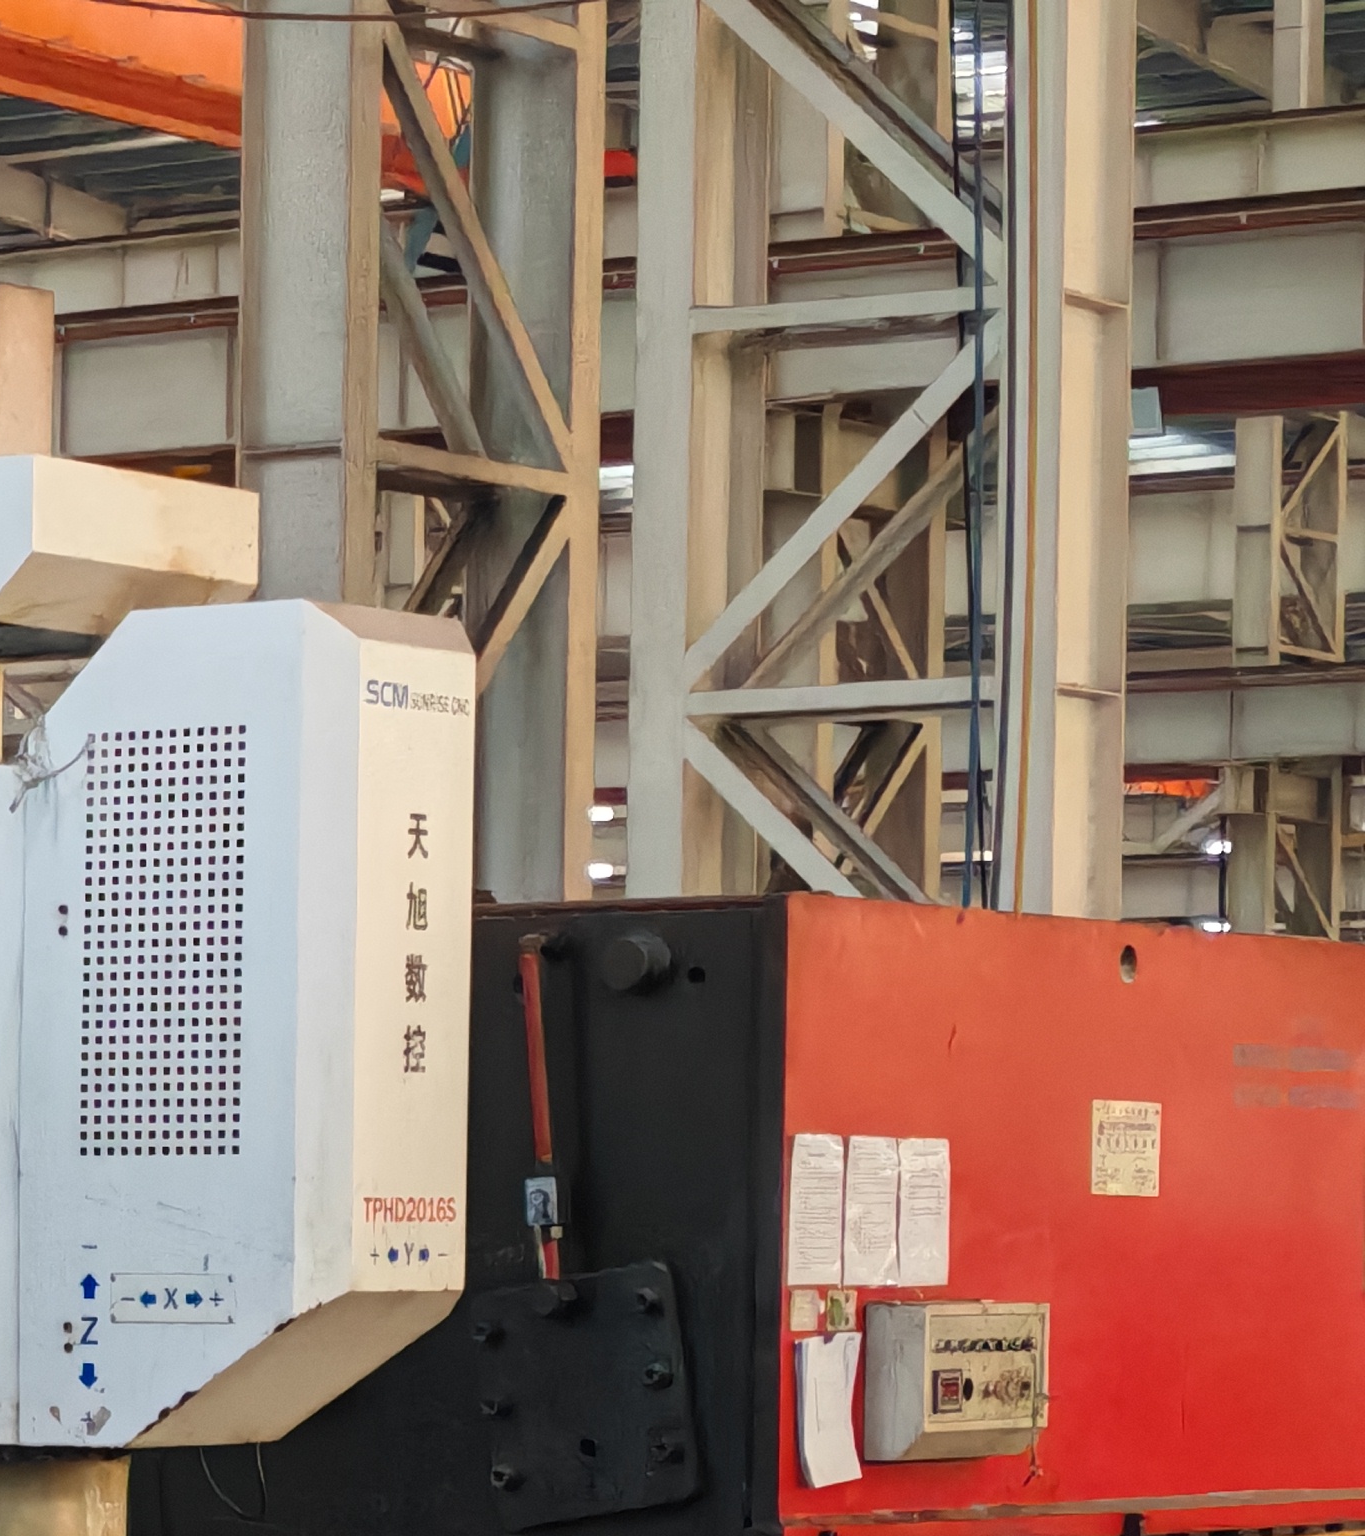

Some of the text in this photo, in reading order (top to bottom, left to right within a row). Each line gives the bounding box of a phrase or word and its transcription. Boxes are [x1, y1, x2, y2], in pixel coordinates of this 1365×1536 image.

[364, 679, 409, 710] SCM
[403, 812, 429, 1073] 天旭数控
[363, 1196, 457, 1223] TPHD2016S
[80, 1316, 99, 1346] Z
